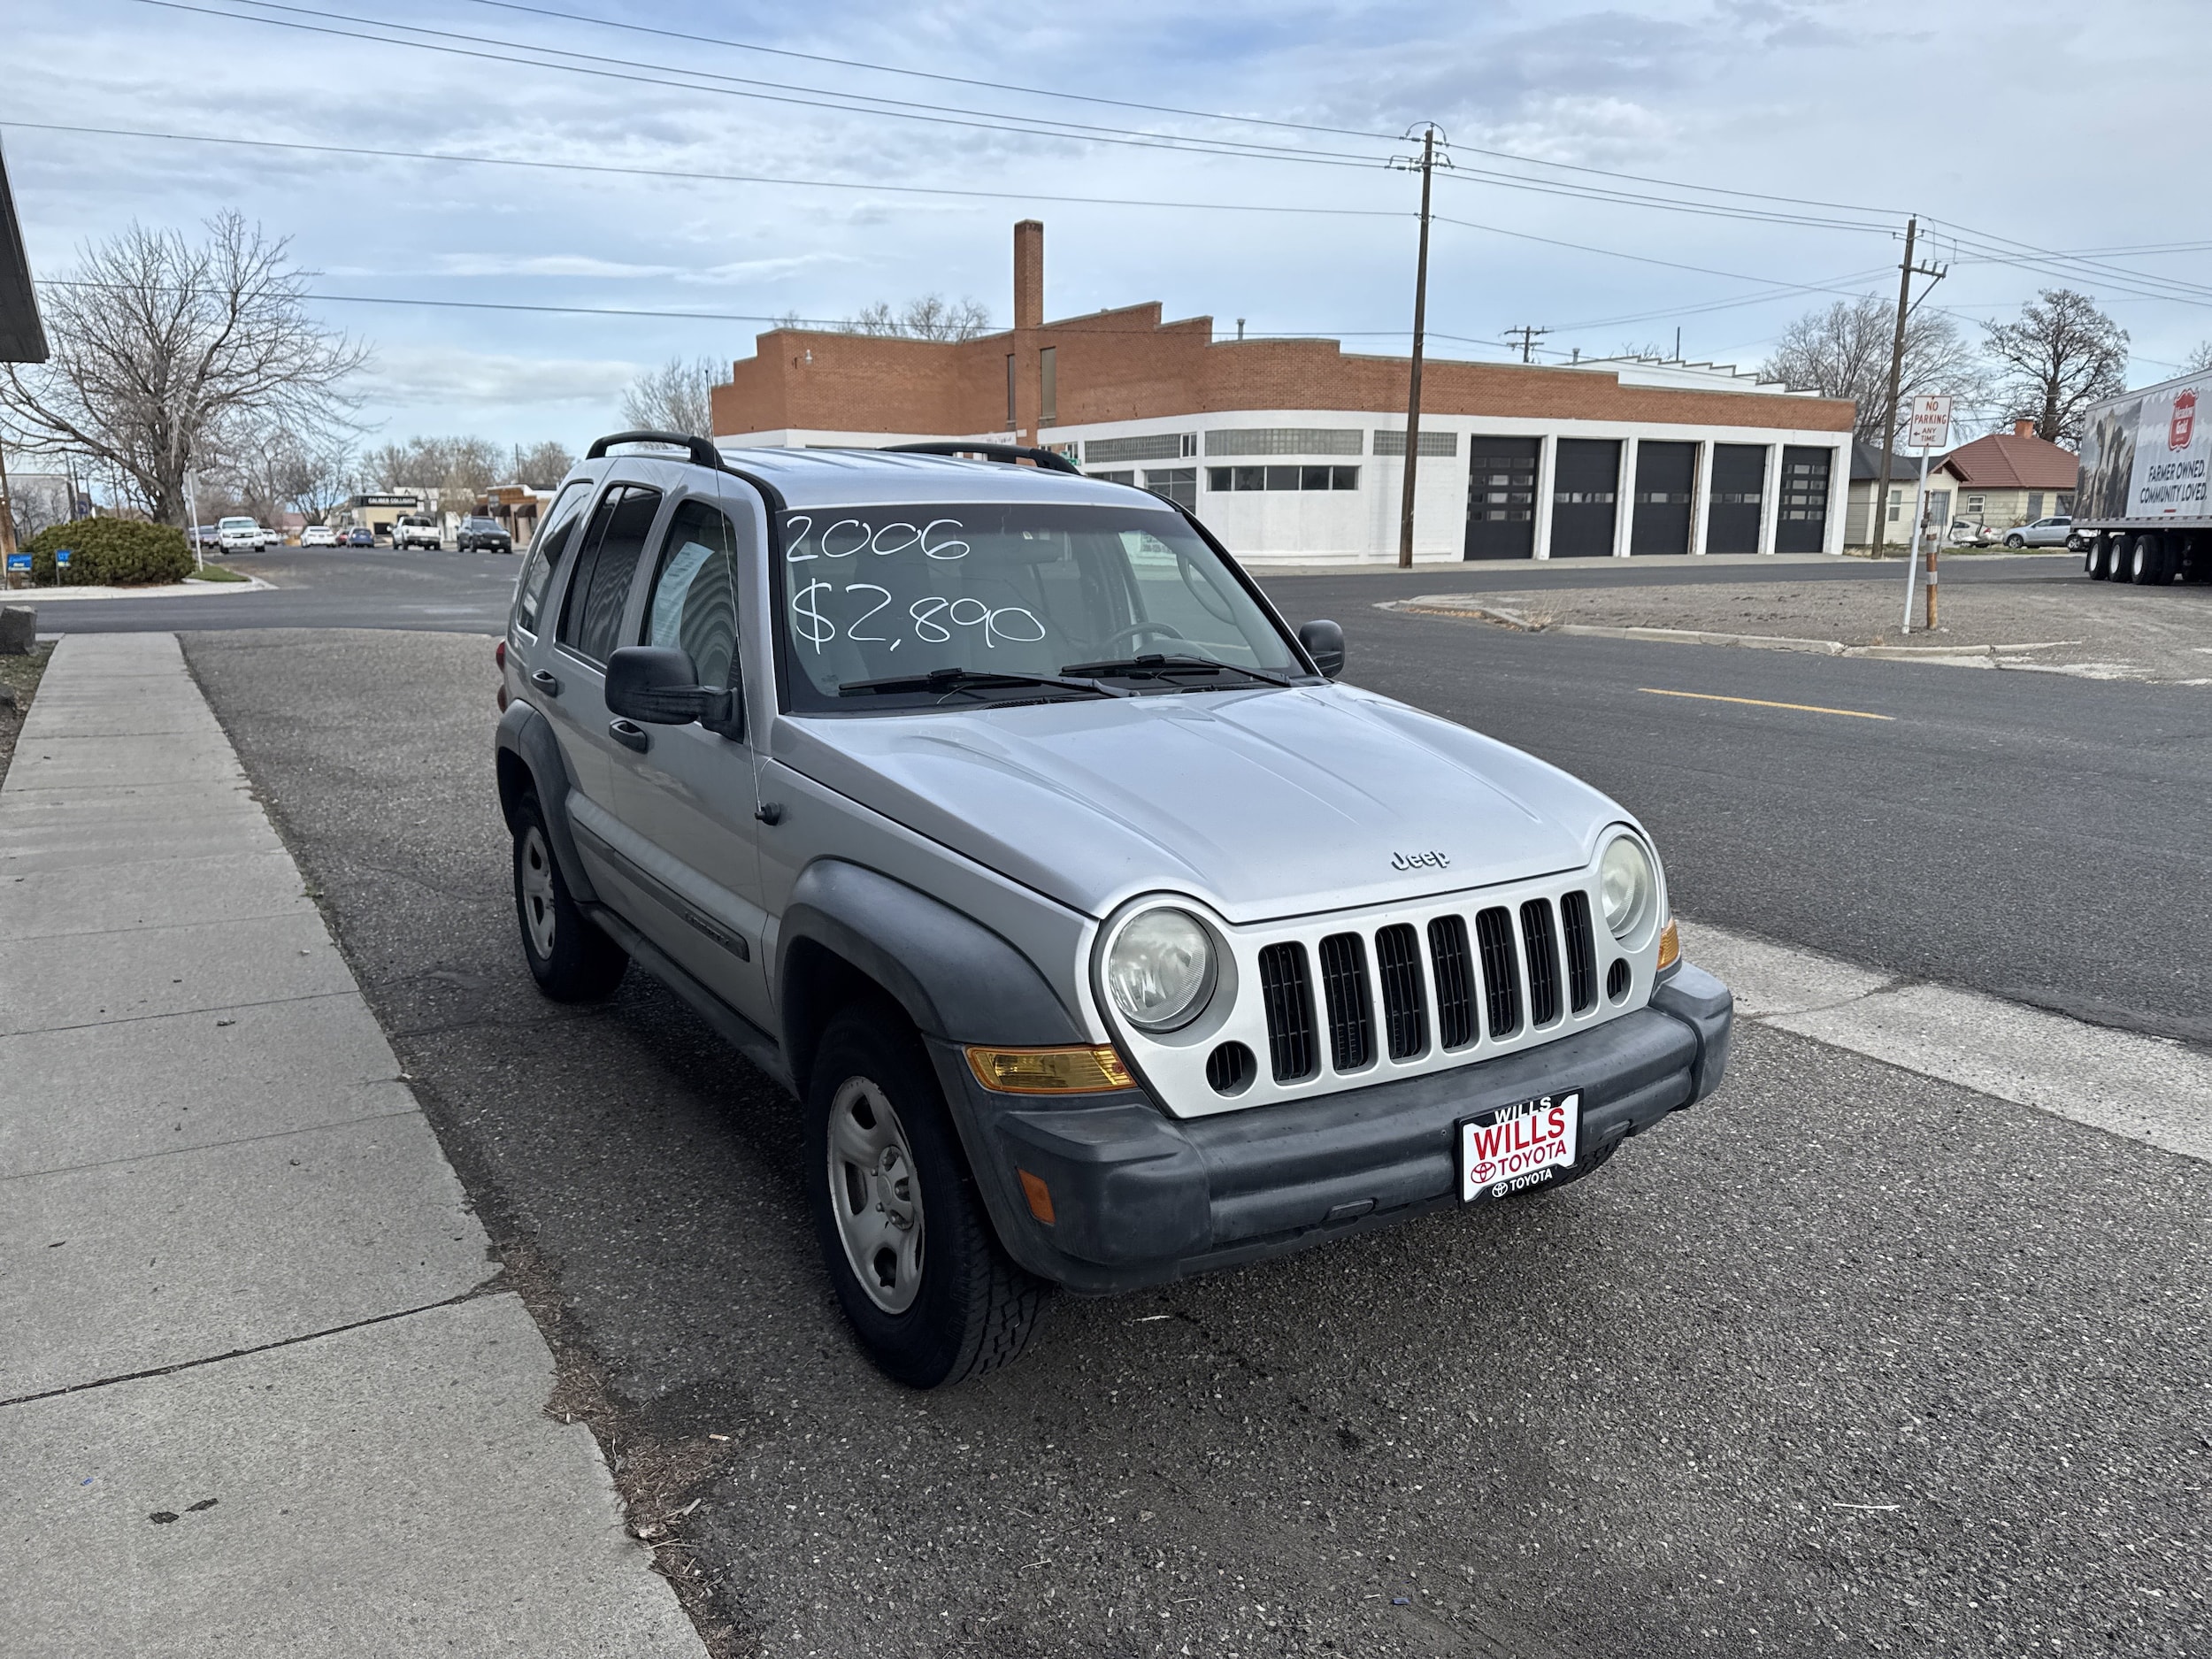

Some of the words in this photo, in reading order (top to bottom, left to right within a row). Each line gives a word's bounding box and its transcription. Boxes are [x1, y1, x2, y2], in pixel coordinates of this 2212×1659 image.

[1925, 401, 1939, 411] NO
[1914, 414, 1947, 425] PARKING
[2148, 463, 2176, 482] FARMER
[2177, 459, 2206, 480] OWNED.
[2140, 484, 2182, 504] COMMUNITY
[2181, 482, 2208, 502] LOVED.
[786, 515, 971, 563] 2006
[792, 578, 1046, 655] $2,890
[1391, 850, 1450, 871] Jeep
[1494, 1096, 1551, 1125] WILLS
[1473, 1107, 1565, 1161] WILLS
[1498, 1140, 1567, 1176] TOYOTA
[1509, 1168, 1553, 1191] TOYOTA
